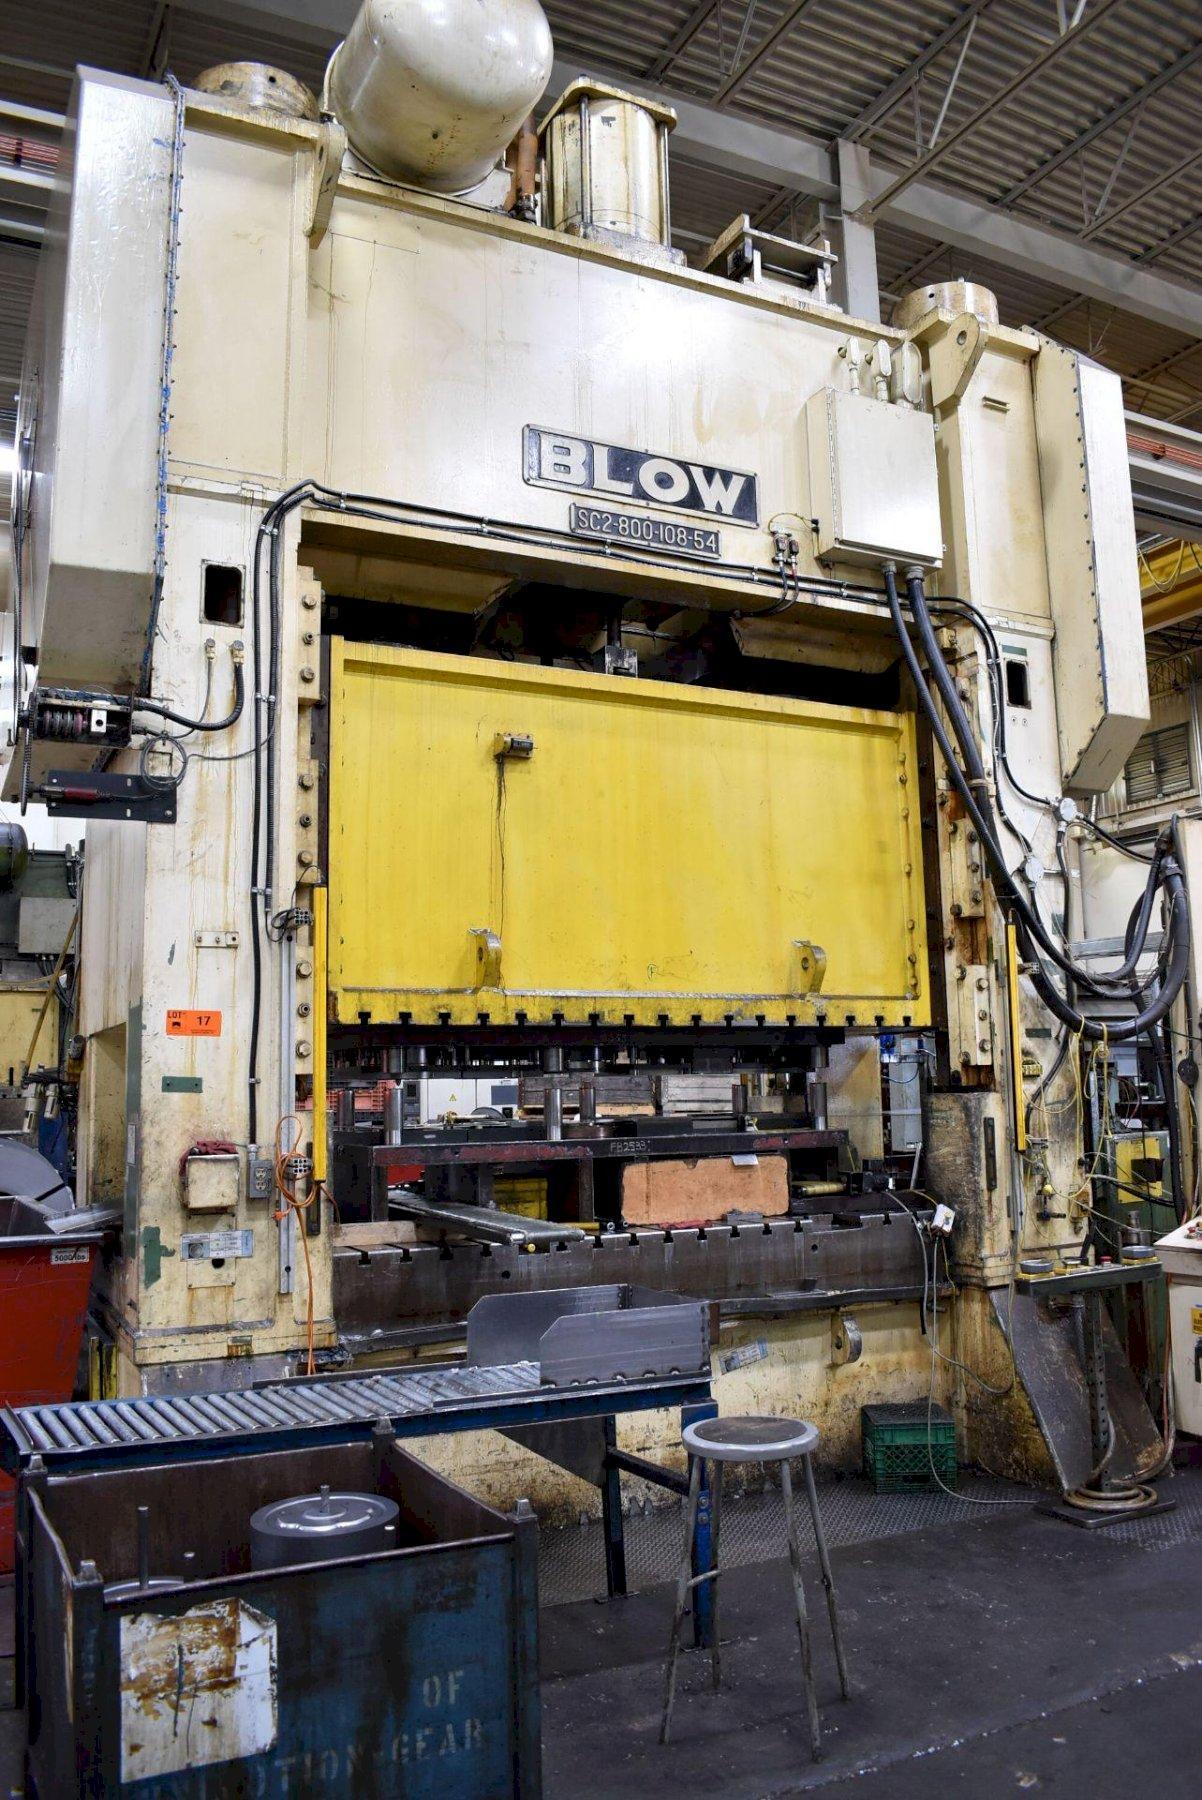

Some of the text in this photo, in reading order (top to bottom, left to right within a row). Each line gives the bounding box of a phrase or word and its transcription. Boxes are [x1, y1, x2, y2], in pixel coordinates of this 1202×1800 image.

[540, 432, 748, 516] BLOW
[168, 1011, 181, 1019] LOT
[196, 1015, 211, 1026] 17
[422, 1670, 464, 1708] OF
